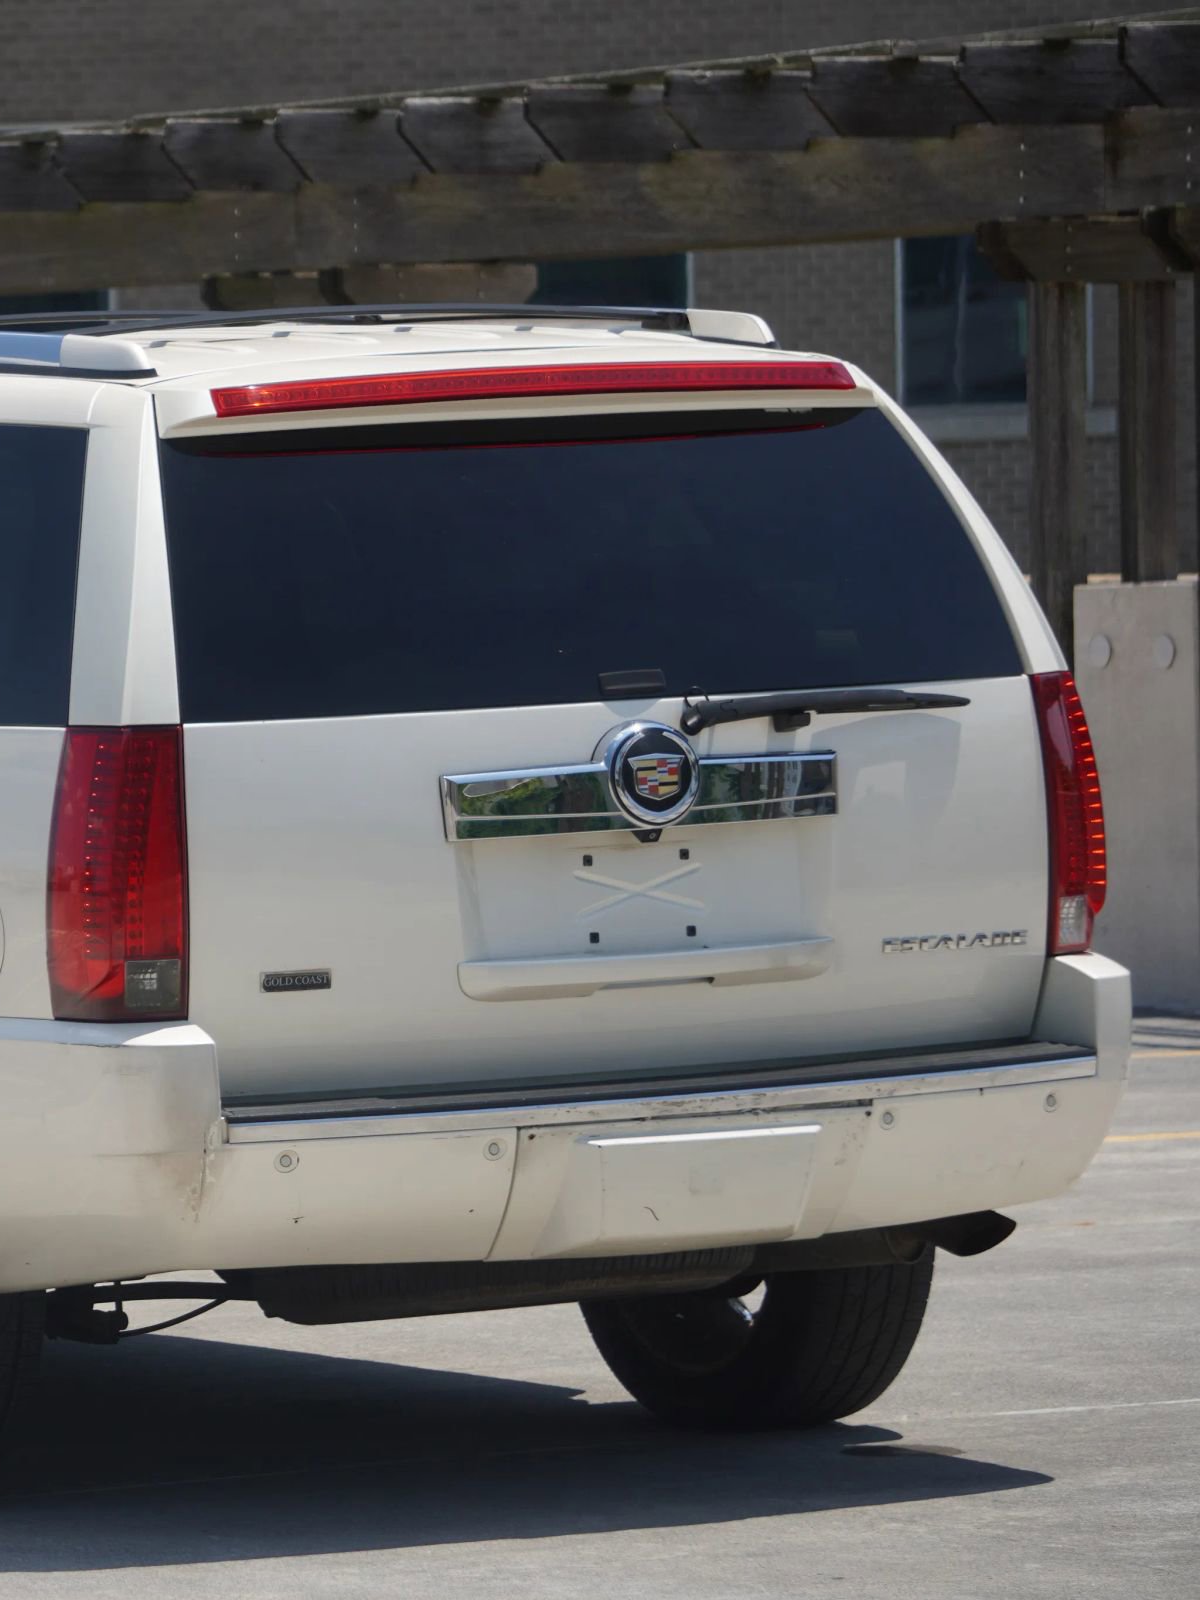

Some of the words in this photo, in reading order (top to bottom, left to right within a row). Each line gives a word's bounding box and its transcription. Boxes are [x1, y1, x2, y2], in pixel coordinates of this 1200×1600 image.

[881, 929, 1028, 954] ESCALADE
[264, 976, 293, 987] GOLD
[295, 974, 329, 985] COAST
